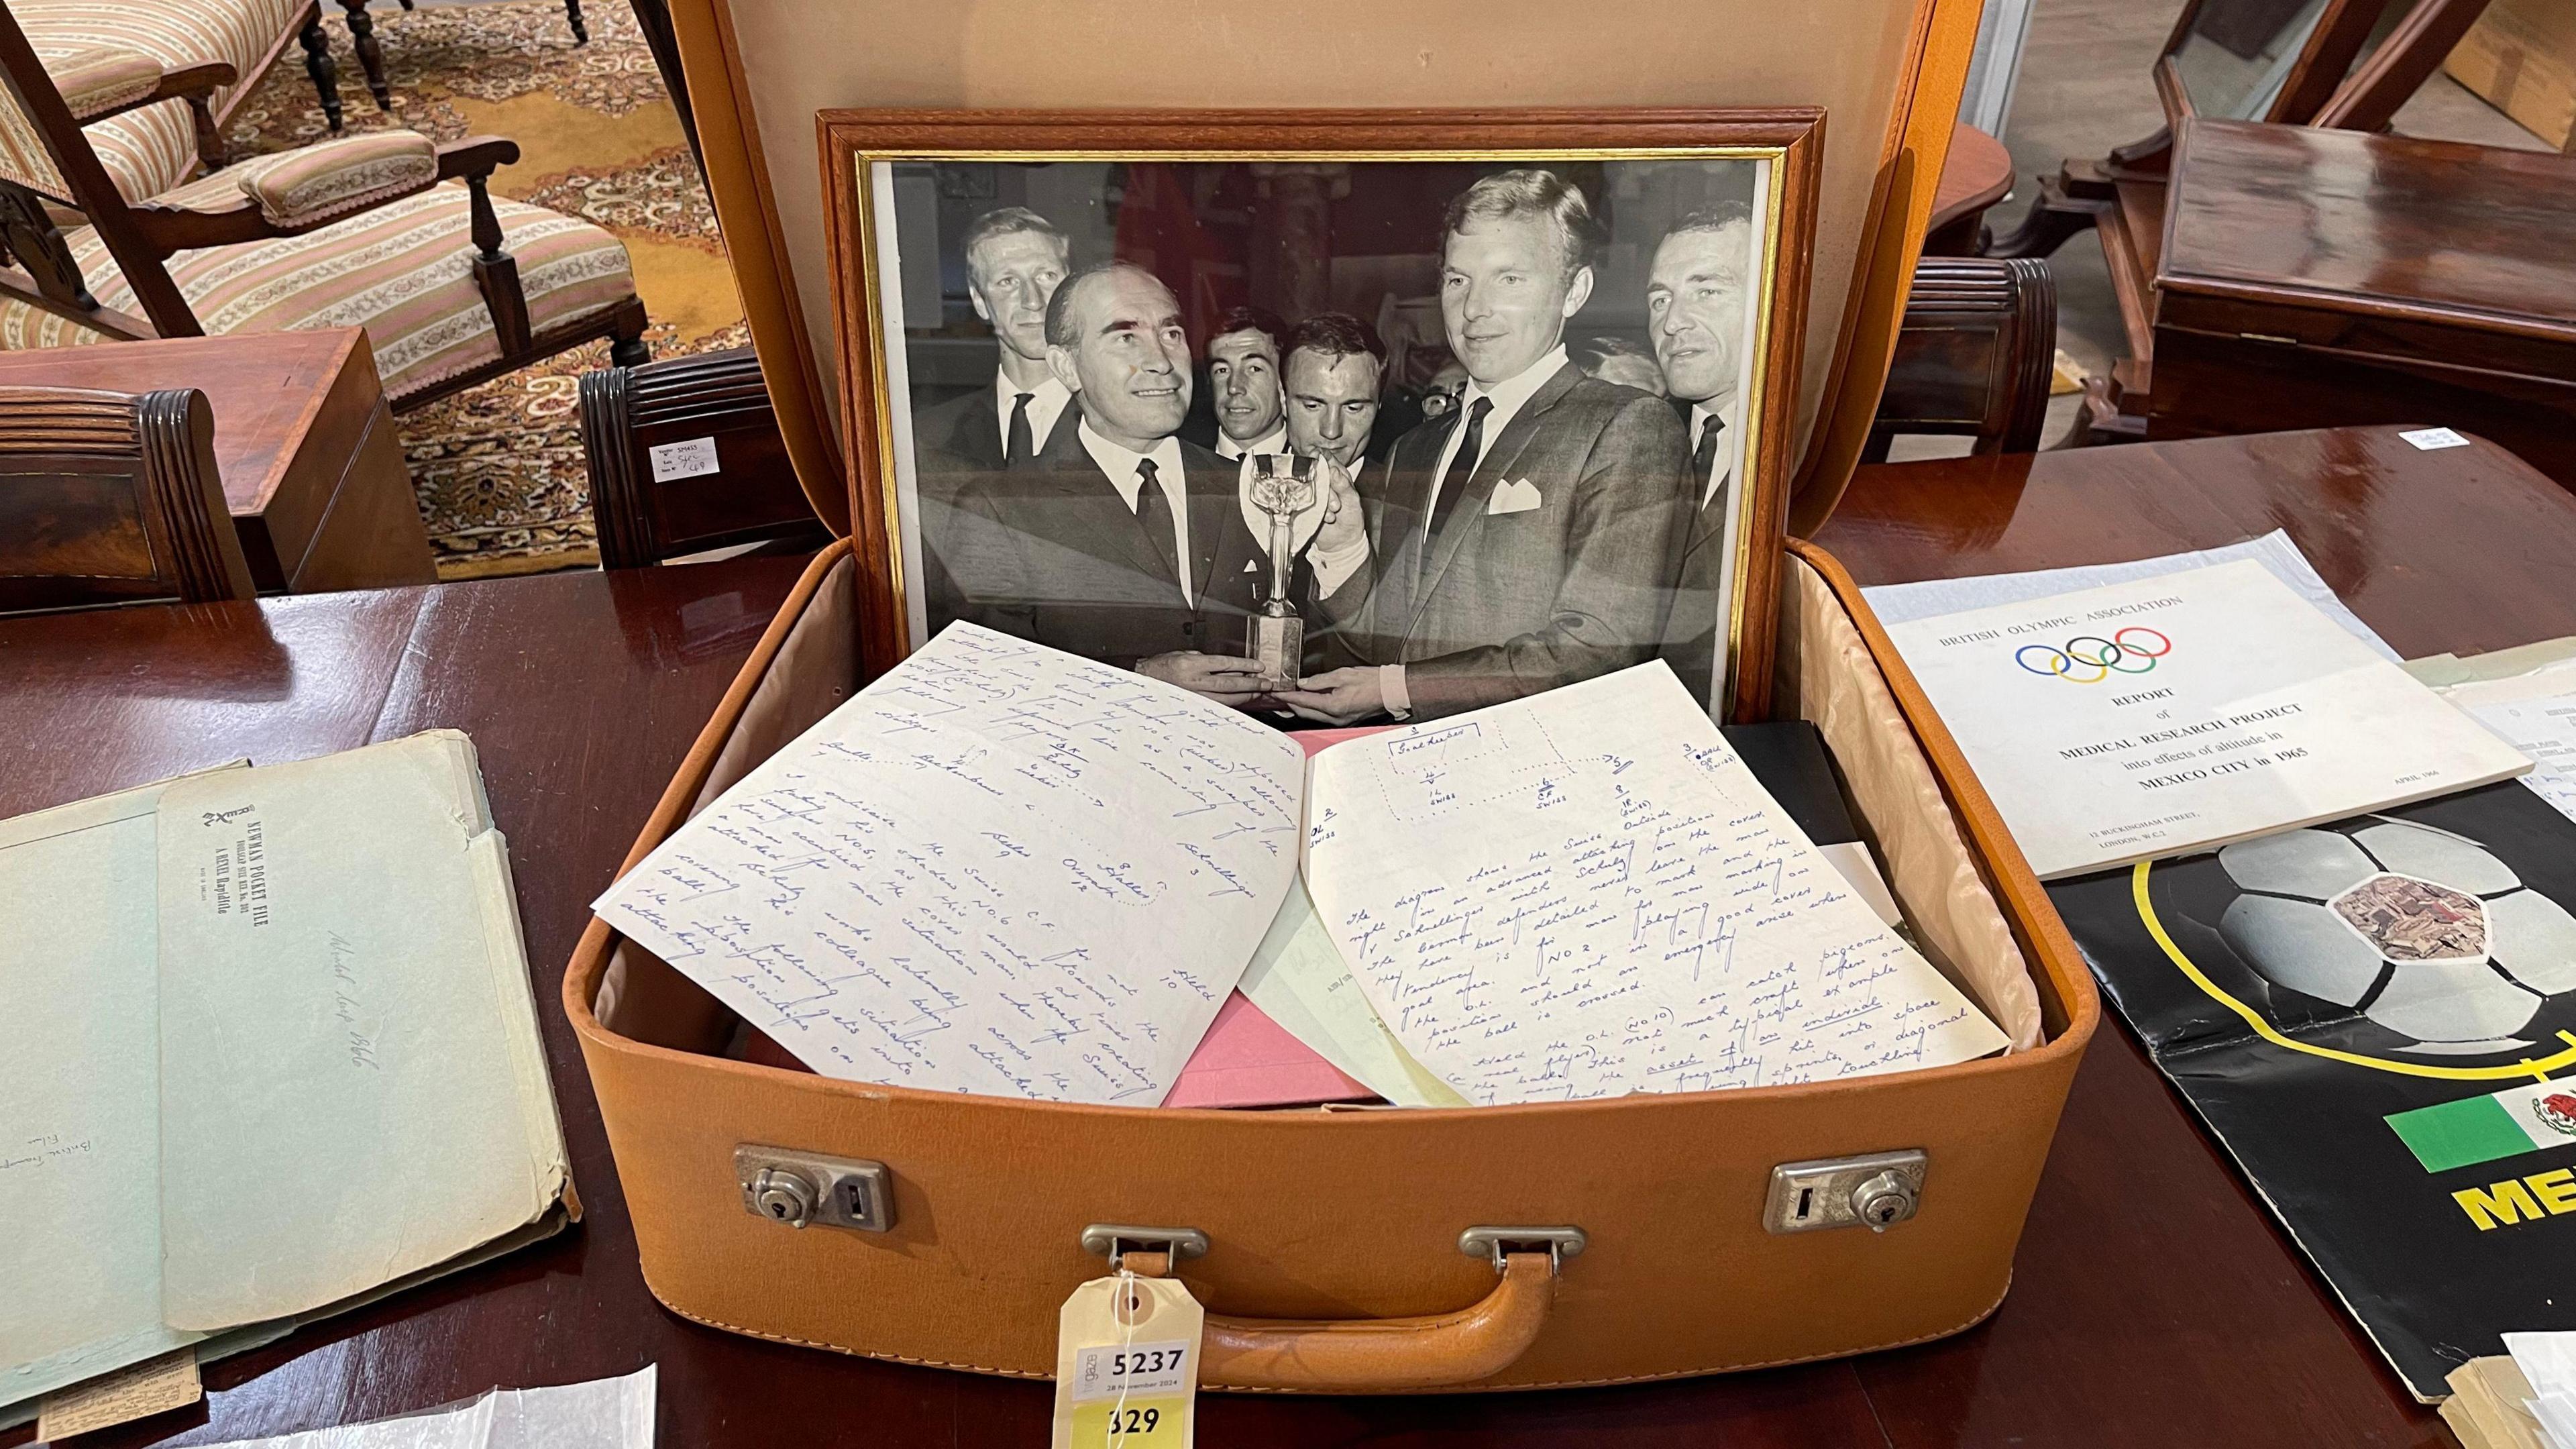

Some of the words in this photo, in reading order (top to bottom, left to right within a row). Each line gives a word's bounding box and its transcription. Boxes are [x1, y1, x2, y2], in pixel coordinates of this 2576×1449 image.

[1938, 630, 2001, 647] BRITISH
[2007, 616, 2077, 635] OLYMPIC
[2086, 596, 2183, 621] ASSOCIATION
[2110, 688, 2175, 707] REPORT
[2156, 709, 2172, 720] of
[2059, 739, 2137, 760] MEDICAL
[2139, 720, 2228, 745] RESEARCH
[2229, 703, 2304, 727] PROJECT
[1613, 757, 1621, 767] 5
[2121, 760, 2151, 771] into
[2153, 751, 2196, 765] effects
[2198, 745, 2215, 756] of
[2214, 736, 2266, 753] altitude
[2265, 731, 2284, 741] in
[2138, 769, 2207, 792] MEXICO
[2211, 759, 2251, 775] CITY
[2254, 757, 2271, 766] in
[2275, 747, 2308, 763] 1965
[1536, 796, 1566, 809] SWISS
[1615, 785, 1623, 793] 8
[202, 806, 251, 827] REXEL
[2100, 819, 2163, 837] BUCKINGHAM
[2163, 812, 2201, 823] STREET,
[247, 821, 264, 862] NEWMAN
[1689, 828, 1710, 841] the
[2098, 837, 2141, 849] LONDON,
[216, 853, 229, 876] REXEL
[922, 843, 944, 857] the
[965, 868, 1004, 898] Swiss
[1120, 862, 1130, 870] 8
[1487, 865, 1552, 893] advanced
[1572, 840, 1635, 879] attacking
[1653, 814, 1714, 853] position
[250, 865, 267, 900] POCKET
[1725, 857, 1782, 896] marking
[214, 877, 231, 914] Rapidfile
[1474, 936, 1504, 951] been
[1534, 900, 1599, 930] detailed
[1656, 865, 1696, 885] mark
[1723, 850, 1754, 865] and
[1766, 838, 1790, 851] the
[1497, 896, 1567, 945] defenders
[1646, 857, 1686, 874] leave
[253, 905, 268, 928] FILE
[1582, 944, 1590, 953] 2
[1640, 902, 1709, 946] playing
[1733, 880, 1768, 896] wide
[1717, 904, 1755, 953] good
[897, 849, 957, 890] shadow
[1055, 963, 1116, 1007] towards
[1135, 1022, 1159, 1042] the
[1530, 979, 1592, 1006] should
[1664, 928, 1736, 981] emergency
[1809, 892, 1847, 909] when
[933, 896, 967, 916] this
[987, 934, 1039, 970] would
[1055, 986, 1079, 1000] at
[1089, 1012, 1129, 1041] times
[1159, 977, 1177, 989] 10
[1173, 969, 1216, 1002] Held
[1746, 962, 1796, 988] catch
[880, 881, 906, 898] the
[1030, 992, 1090, 1043] thereby
[1098, 1043, 1157, 1100] creating
[1680, 1005, 1729, 1028] much
[1750, 980, 1799, 1022] craft
[987, 1027, 1032, 1061] across
[999, 992, 1035, 1020] when
[1083, 1053, 1124, 1089] Swiss
[1484, 1021, 1517, 1039] ball
[1838, 1022, 1872, 1038] into
[1896, 1008, 1968, 1062] diagonal
[1647, 1053, 1699, 1073] asset
[2450, 1165, 2576, 1232] ME
[1085, 1354, 1099, 1382] gaze
[1112, 1349, 1184, 1376] 5237
[1118, 1382, 1157, 1391] Nvember
[1159, 1379, 1177, 1387] 2024
[1107, 1408, 1159, 1435] 329
